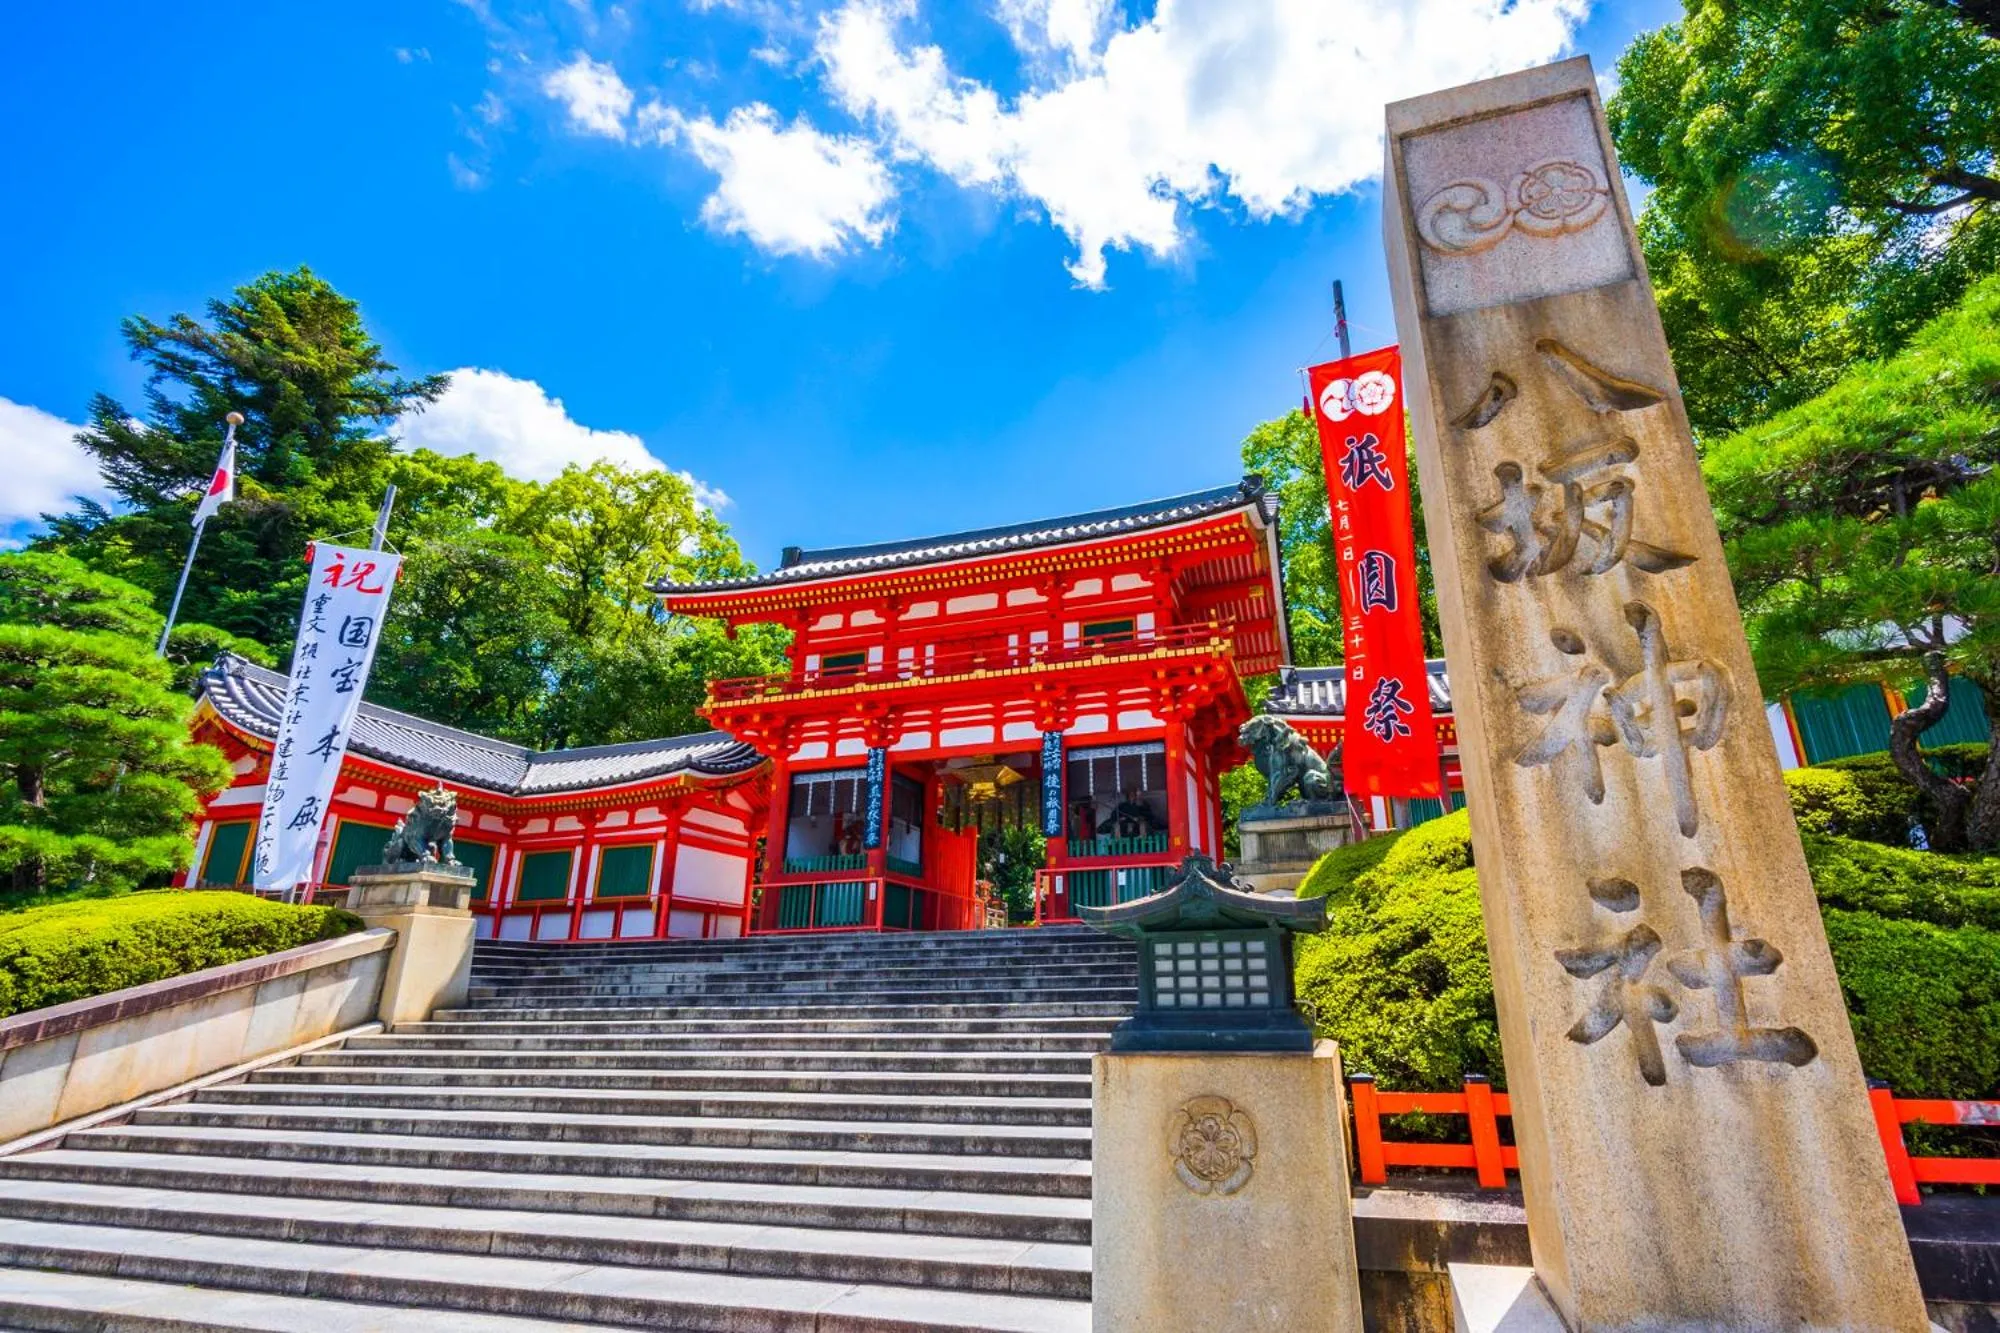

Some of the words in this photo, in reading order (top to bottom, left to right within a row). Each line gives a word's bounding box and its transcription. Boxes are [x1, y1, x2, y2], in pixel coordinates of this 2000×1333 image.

[322, 553, 384, 594] 祝
[1341, 433, 1413, 744] 祇園祭
[1450, 338, 1819, 1086] 八坂神社
